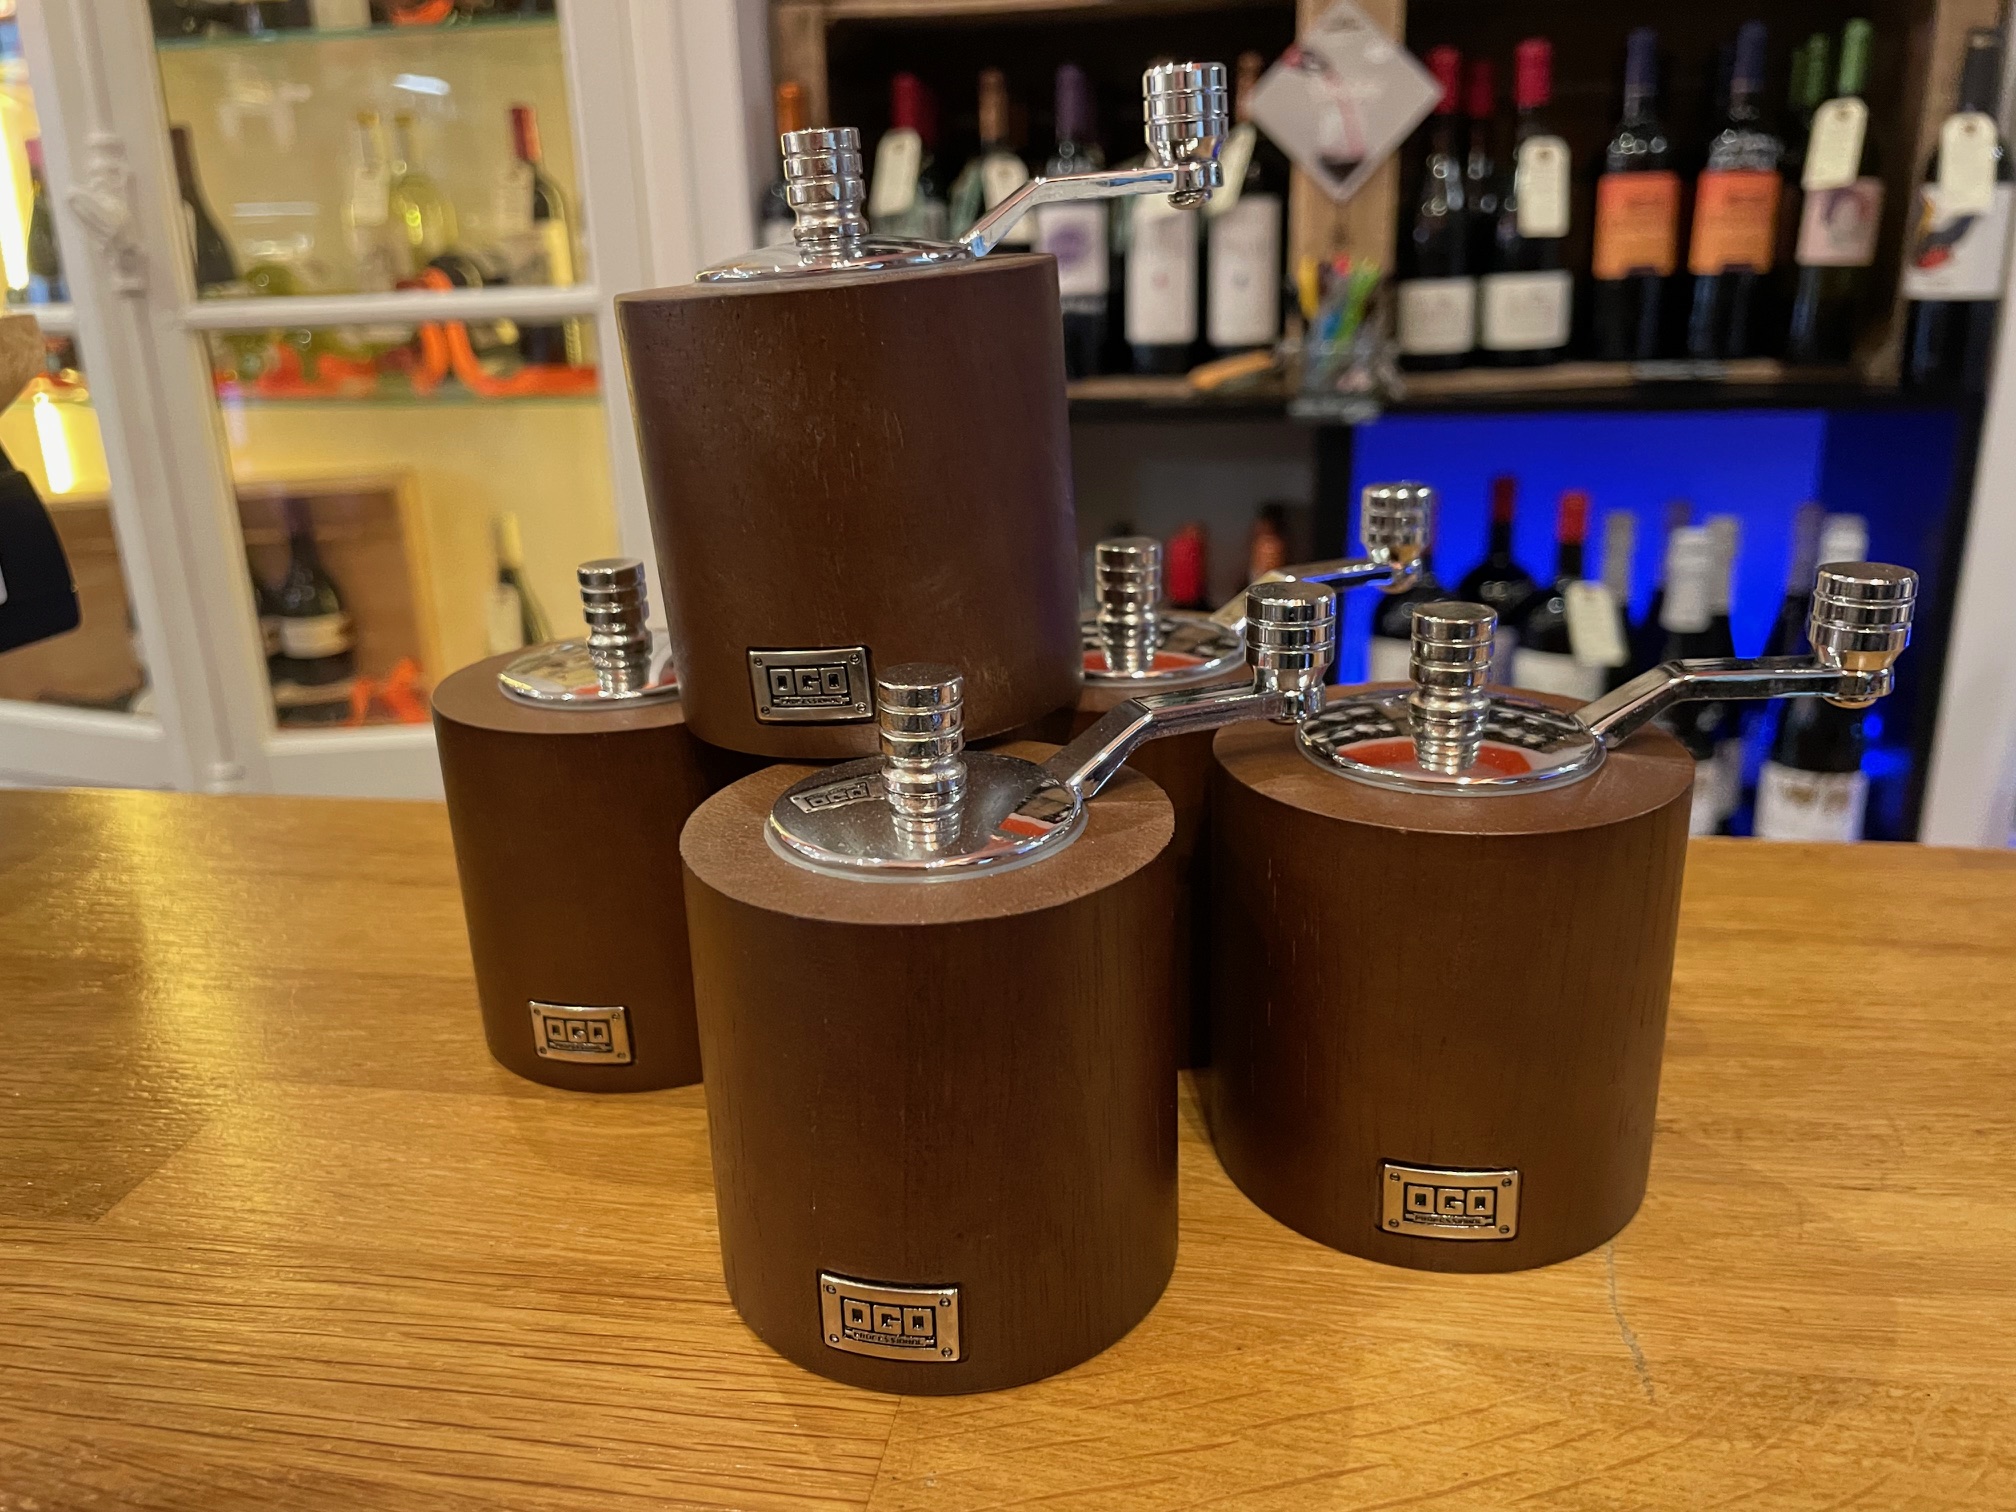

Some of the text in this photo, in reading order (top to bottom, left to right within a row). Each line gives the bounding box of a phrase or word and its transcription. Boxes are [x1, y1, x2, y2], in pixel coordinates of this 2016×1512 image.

[770, 666, 848, 696] OGO
[546, 1018, 611, 1043] OGO
[1406, 1184, 1495, 1216] OGO
[843, 1298, 934, 1336] OGO
